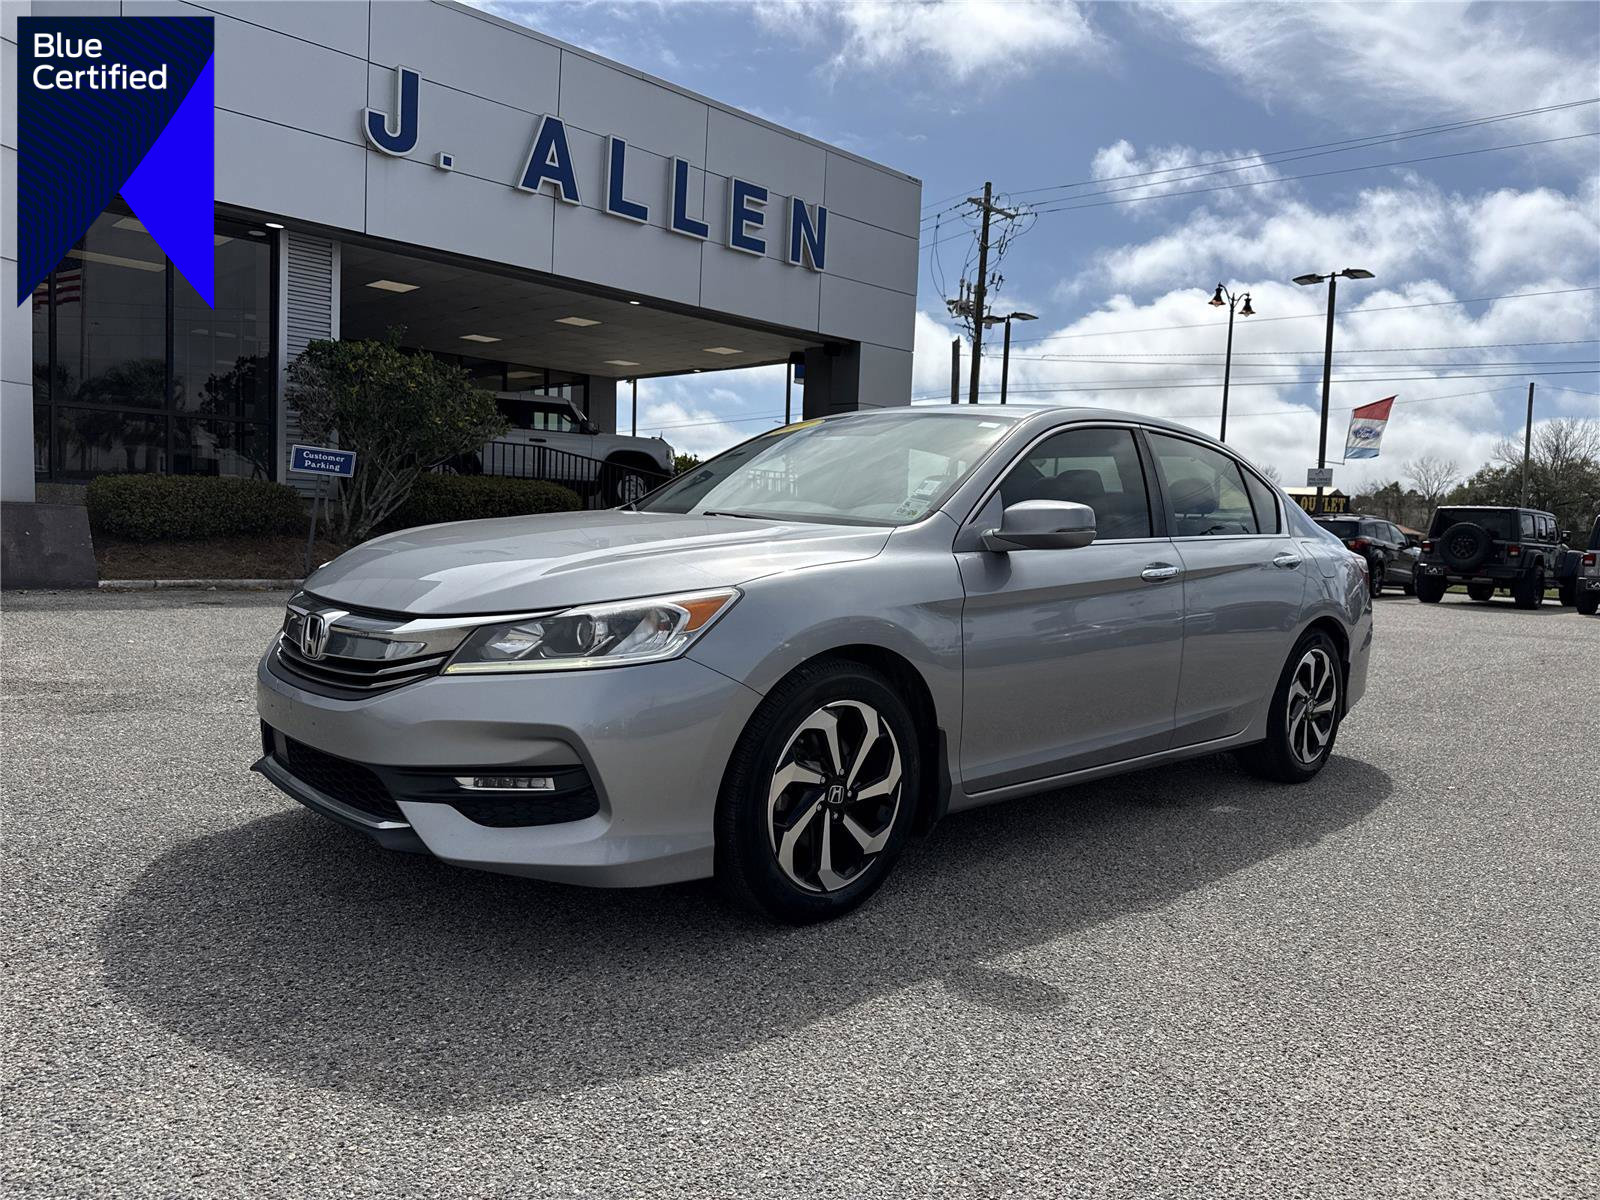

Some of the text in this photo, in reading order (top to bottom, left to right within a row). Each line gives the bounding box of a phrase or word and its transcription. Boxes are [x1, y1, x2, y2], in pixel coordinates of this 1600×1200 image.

[361, 65, 829, 272] J. ALLEN
[303, 451, 344, 462] Customer
[304, 460, 340, 471] Parking
[1301, 496, 1346, 513] OULET
